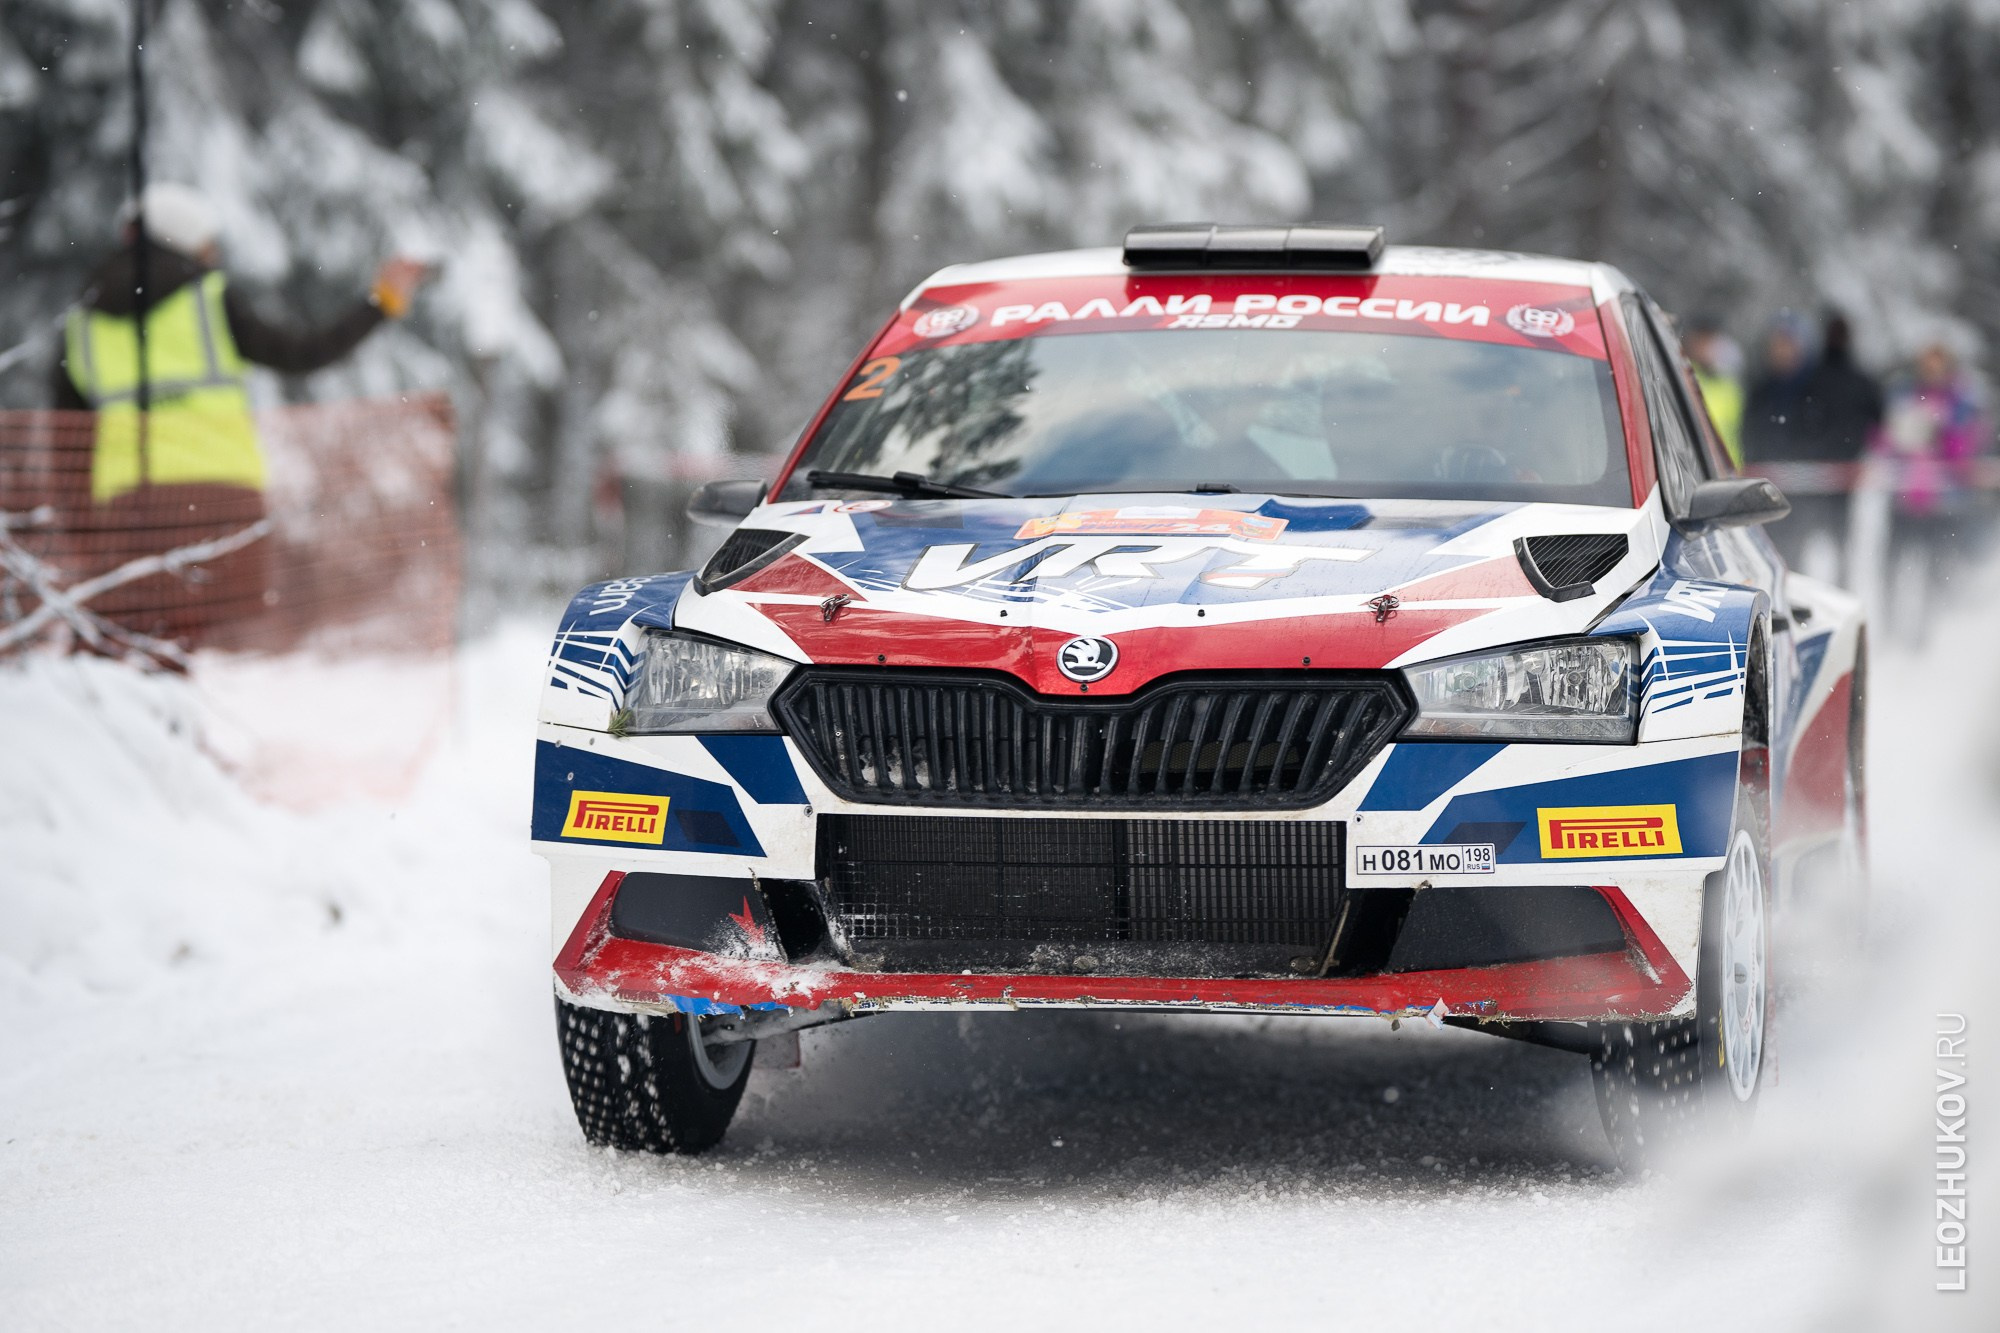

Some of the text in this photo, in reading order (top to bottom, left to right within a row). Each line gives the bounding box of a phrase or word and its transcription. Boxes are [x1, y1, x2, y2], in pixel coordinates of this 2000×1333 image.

[990, 294, 1213, 327] РАЛЛИ
[1232, 294, 1491, 327] РОССИИ
[843, 356, 901, 401] 2
[900, 535, 1381, 591] VRT
[1658, 580, 1729, 623] VRT
[572, 800, 660, 834] PIRELLI
[1549, 817, 1665, 849] PIRELLI
[1465, 847, 1491, 862] 198
